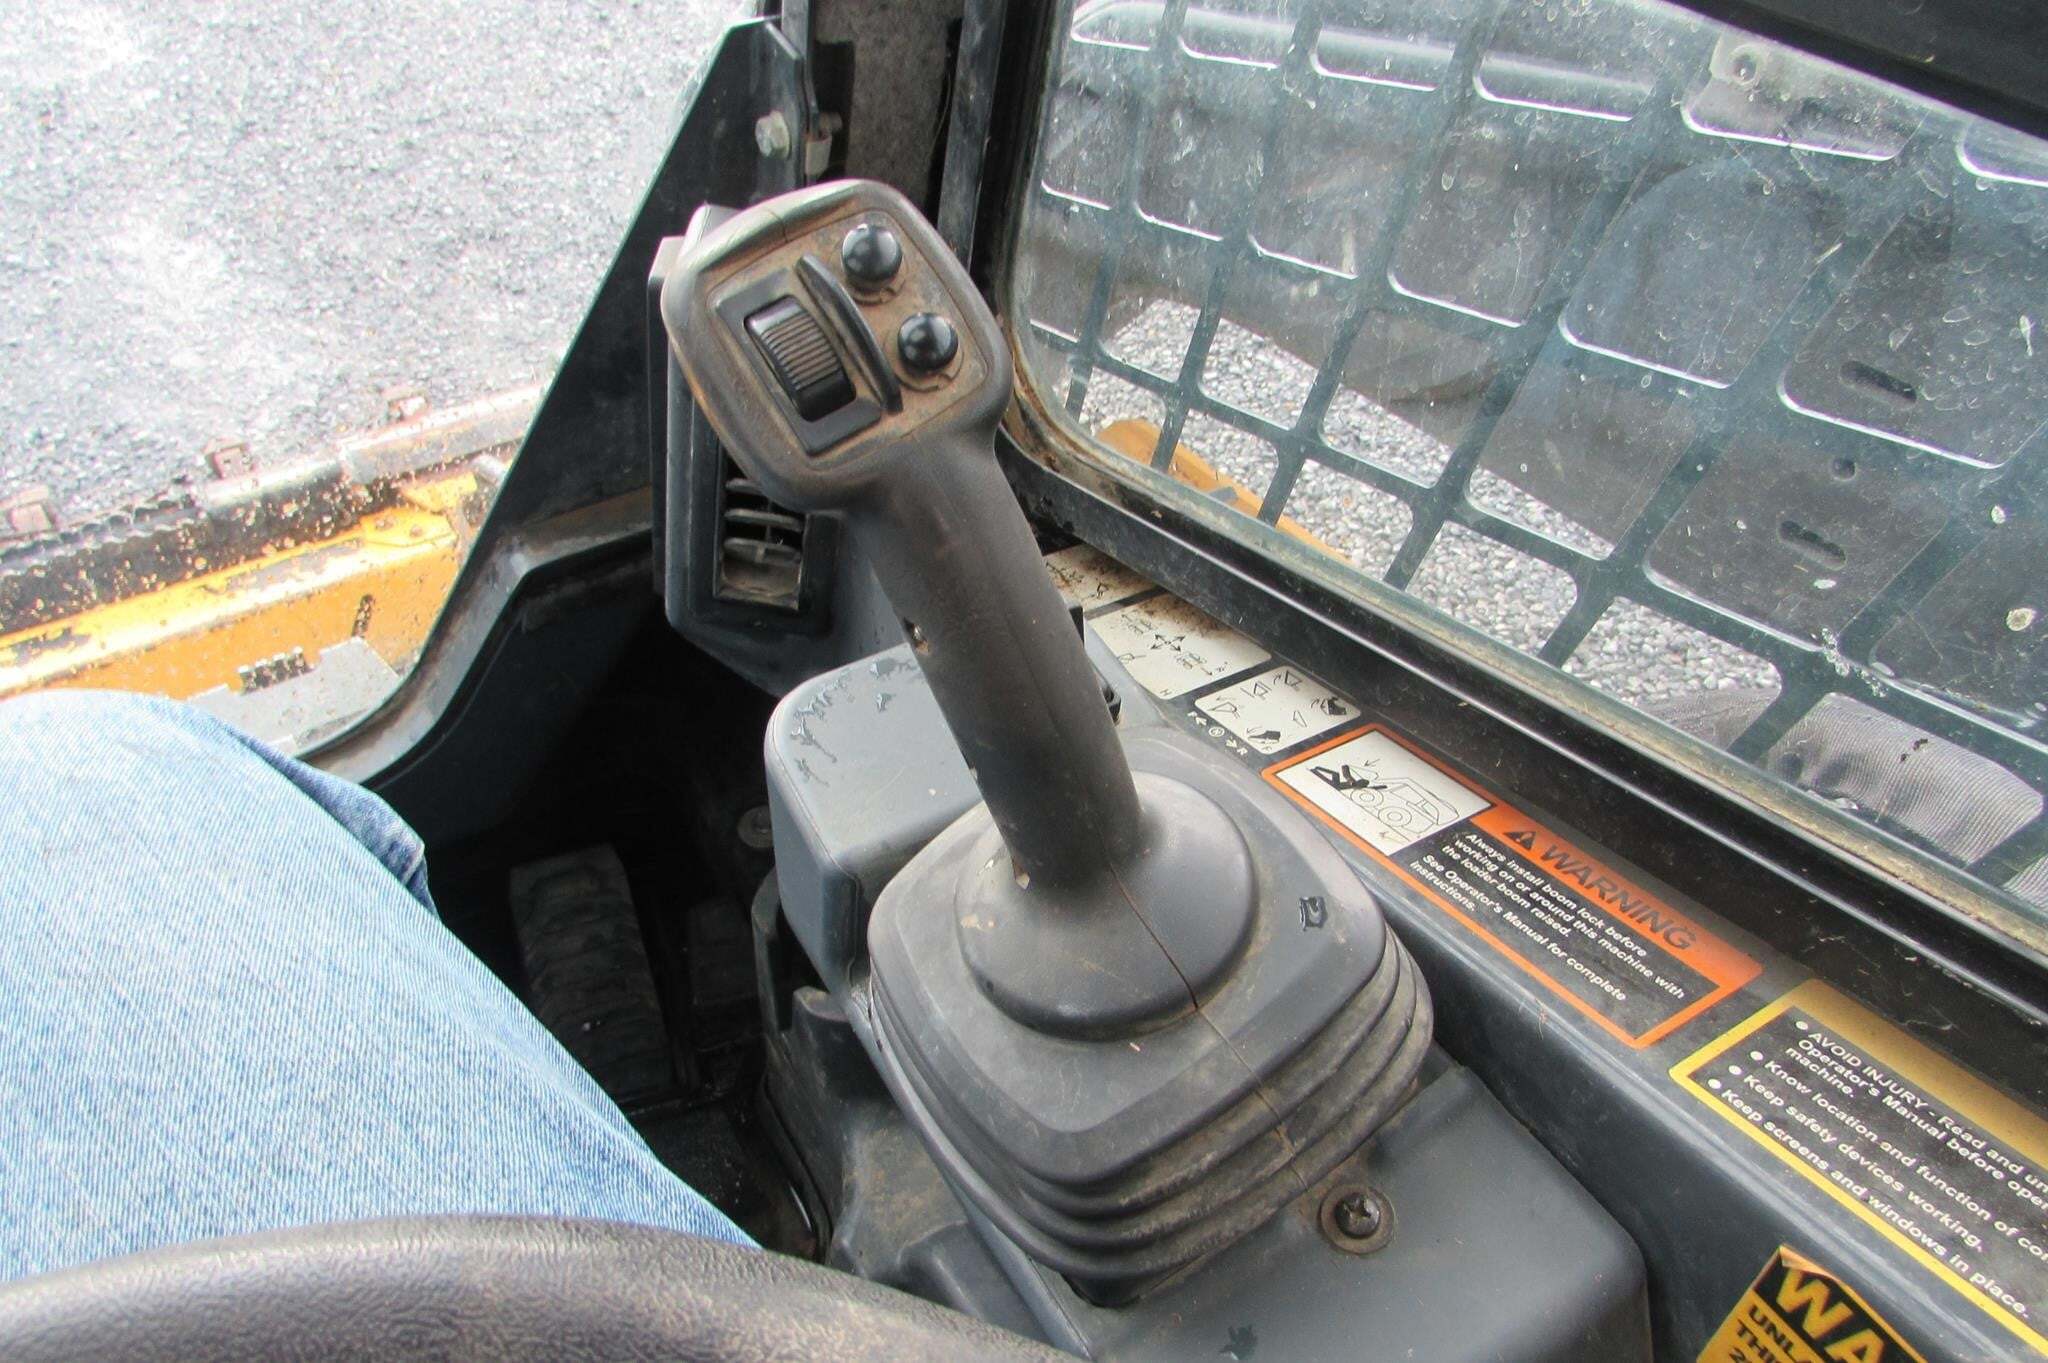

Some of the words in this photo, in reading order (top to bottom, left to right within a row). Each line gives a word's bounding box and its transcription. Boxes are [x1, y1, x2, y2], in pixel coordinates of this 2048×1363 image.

[1410, 861, 1476, 912] instructions.
[1423, 854, 1444, 872] See
[1445, 870, 1503, 913] Operator's
[1503, 910, 1549, 948] Manual
[1547, 941, 1567, 959] for
[1566, 957, 1627, 1001] complete
[1442, 846, 1461, 860] the
[1461, 858, 1498, 884] loader
[1497, 882, 1531, 909] boom
[1530, 906, 1571, 938] raised.
[1455, 839, 1499, 872] working
[1499, 870, 1515, 882] on
[1516, 882, 1531, 892] or
[1529, 888, 1574, 923] around
[1573, 918, 1599, 940] this
[1598, 937, 1653, 978] machine
[1654, 975, 1685, 1000] with
[1465, 834, 1506, 862] Always
[1507, 860, 1544, 886] install
[1541, 883, 1577, 910] boom
[1576, 903, 1605, 928] lock
[1604, 926, 1647, 957] before
[1541, 845, 1698, 950] WARNING
[1743, 1075, 1785, 1107] Keep
[1786, 1106, 1837, 1143] safety
[1838, 1142, 1904, 1192] devices
[1785, 1048, 1854, 1098] machine.
[1798, 1040, 1880, 1096] Operator's
[1883, 1095, 1948, 1141] Manual
[1946, 1137, 2004, 1180] before
[1808, 1032, 1861, 1066] AVOID
[1862, 1066, 1929, 1108] INJURY
[1938, 1115, 1987, 1149] Read
[1986, 1149, 2024, 1175] and
[1722, 1089, 1763, 1123] Keep
[1764, 1121, 1830, 1171] screens
[1831, 1169, 1867, 1198] and
[1867, 1196, 1947, 1257] windows
[1949, 1255, 1969, 1273] in
[1764, 1060, 1812, 1094] Know
[1812, 1093, 1878, 1142] location
[1880, 1140, 1916, 1168] and
[1917, 1165, 1992, 1221] function
[1994, 1220, 2019, 1236] of
